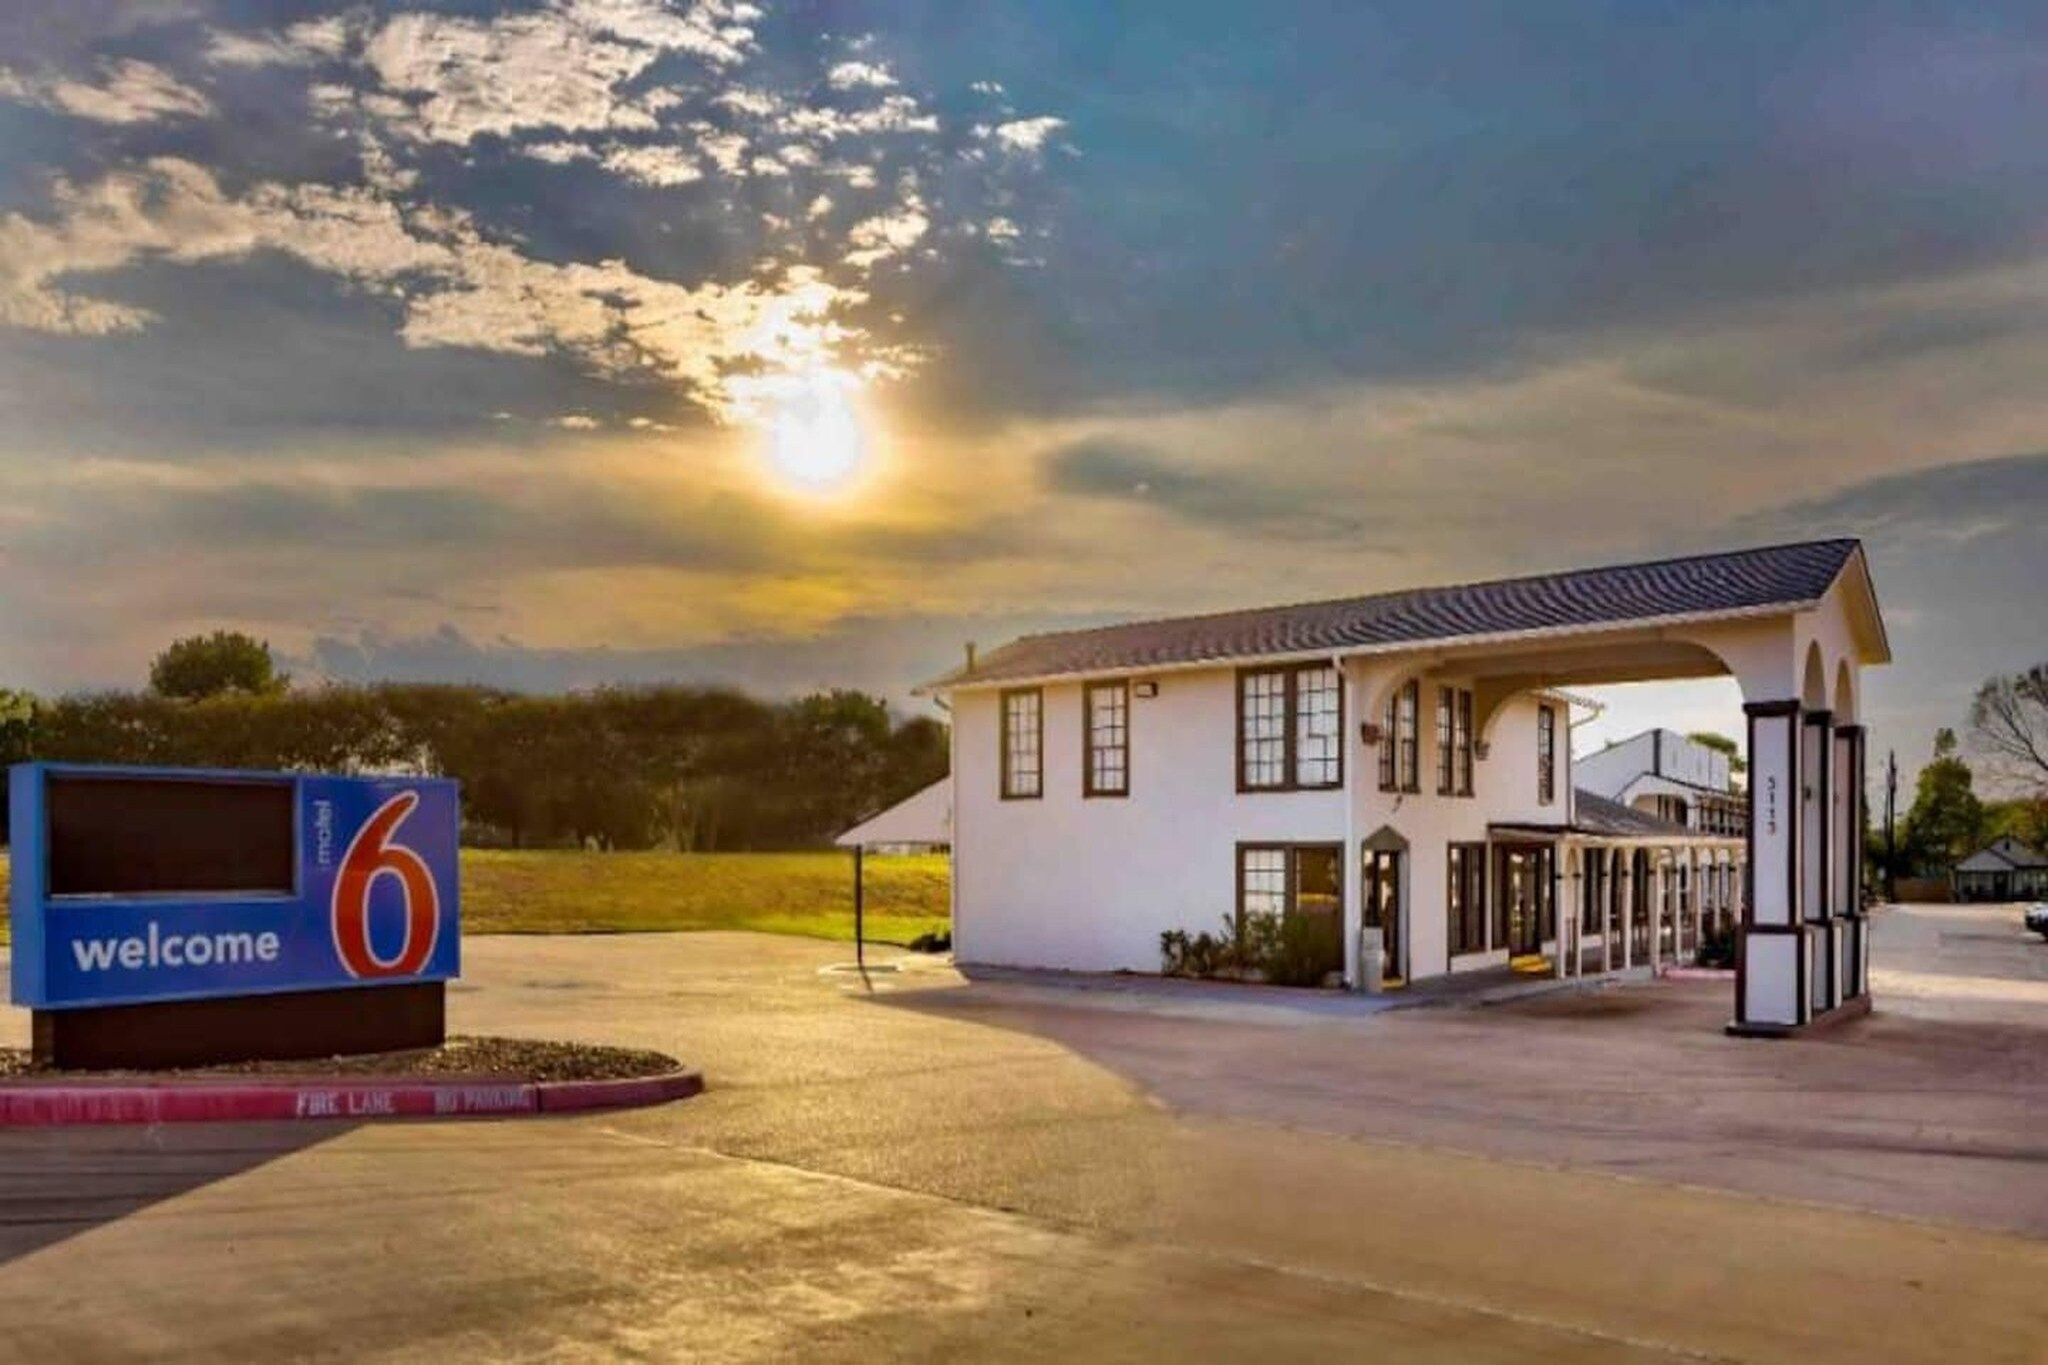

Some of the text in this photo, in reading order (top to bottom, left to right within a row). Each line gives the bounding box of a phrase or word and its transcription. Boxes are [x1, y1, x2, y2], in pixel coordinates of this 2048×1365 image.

[313, 789, 441, 979] motel 6
[72, 921, 281, 972] welcome
[348, 1091, 394, 1114] LANE
